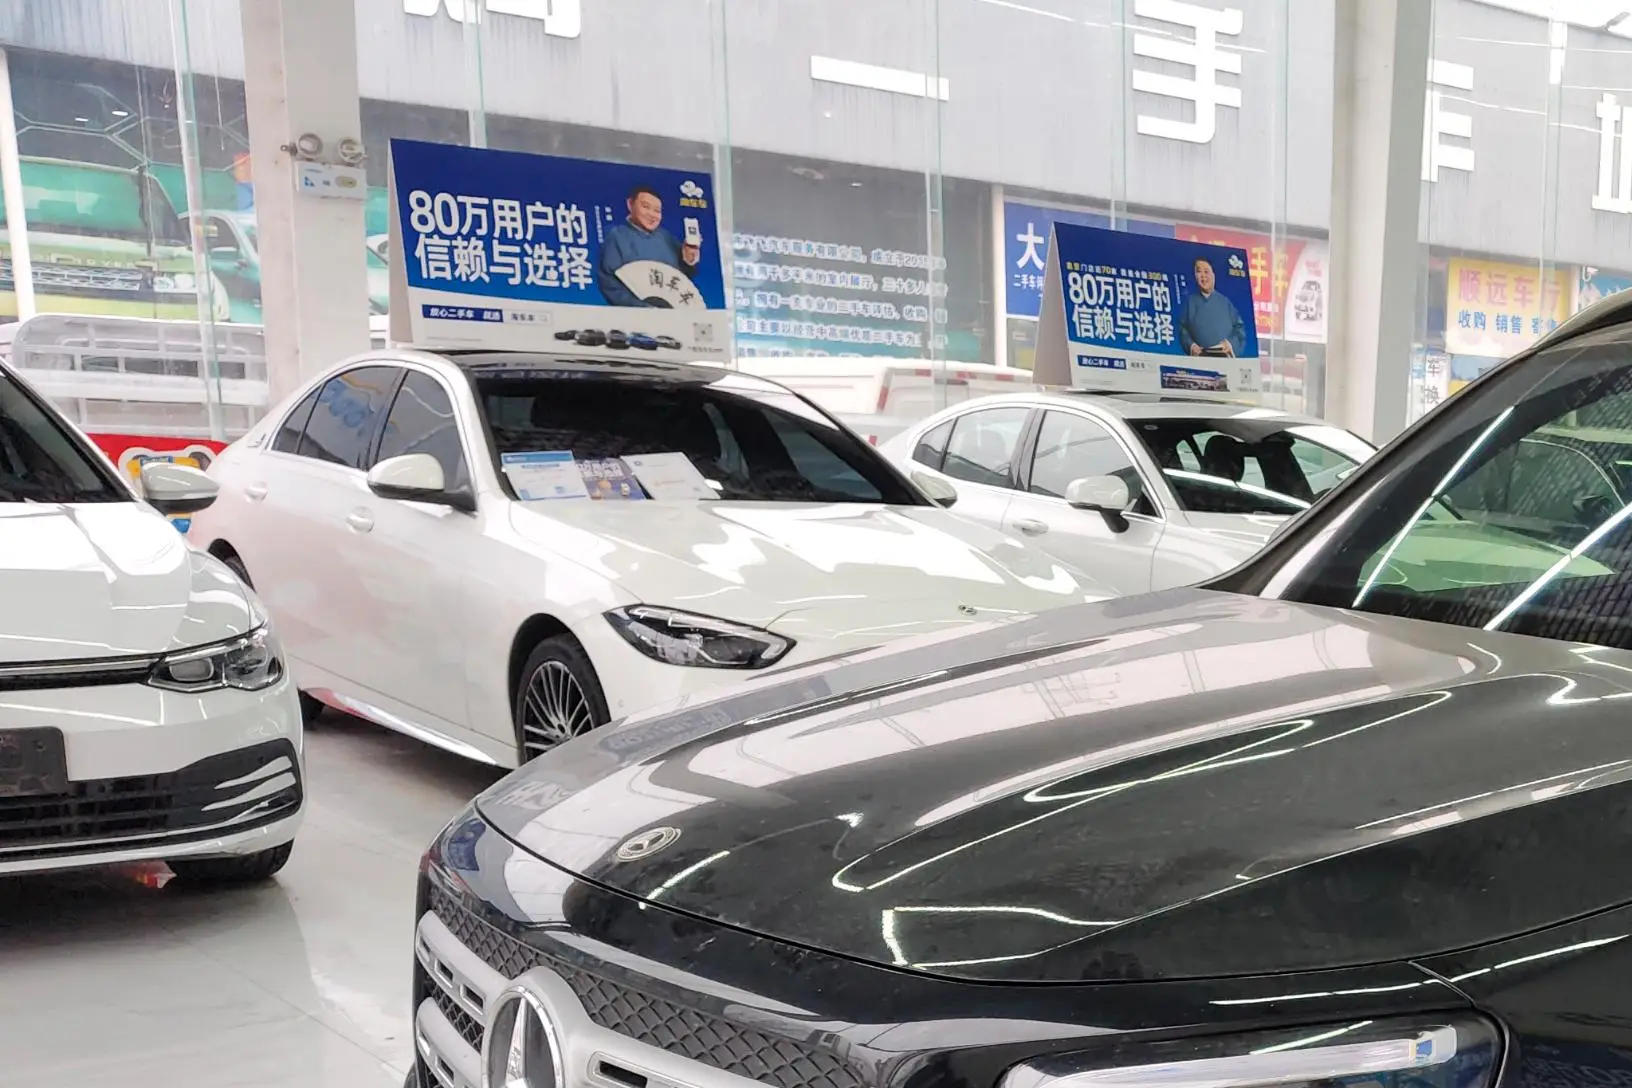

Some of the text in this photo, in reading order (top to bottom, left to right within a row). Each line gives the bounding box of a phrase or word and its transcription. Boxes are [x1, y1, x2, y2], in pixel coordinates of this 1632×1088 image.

[407, 190, 588, 245] 80万用户的
[414, 233, 594, 290] 信赖与选择
[1067, 271, 1172, 313] 80万用户的
[1071, 304, 1175, 346] 信赖与选择
